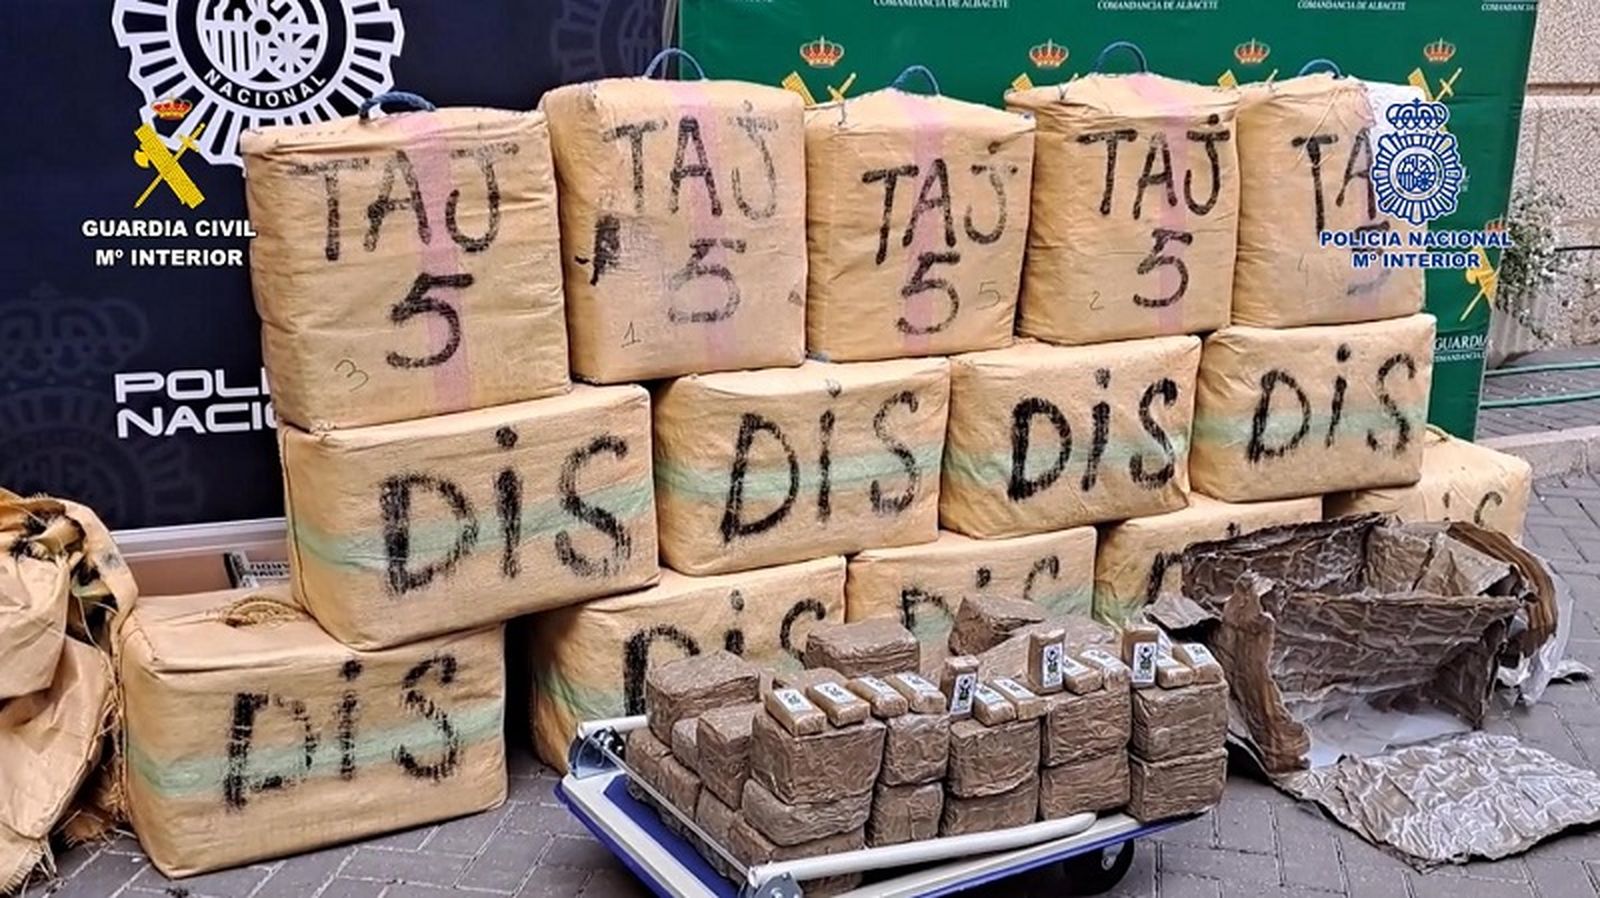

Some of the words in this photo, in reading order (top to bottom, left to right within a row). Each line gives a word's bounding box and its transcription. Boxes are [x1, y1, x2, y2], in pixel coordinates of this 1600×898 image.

[204, 68, 327, 108] NACIONAL
[286, 142, 519, 262] TAJ
[602, 100, 782, 221] TAJ
[862, 141, 1018, 265] TAJ
[1077, 114, 1231, 221] TAJ
[666, 238, 746, 324] 5
[895, 251, 963, 336] 5
[975, 280, 1002, 311] 5
[1089, 289, 1105, 311] 2
[1133, 229, 1193, 308] 5
[385, 272, 475, 368] 5
[335, 358, 370, 392] 3
[116, 401, 278, 439] NACI
